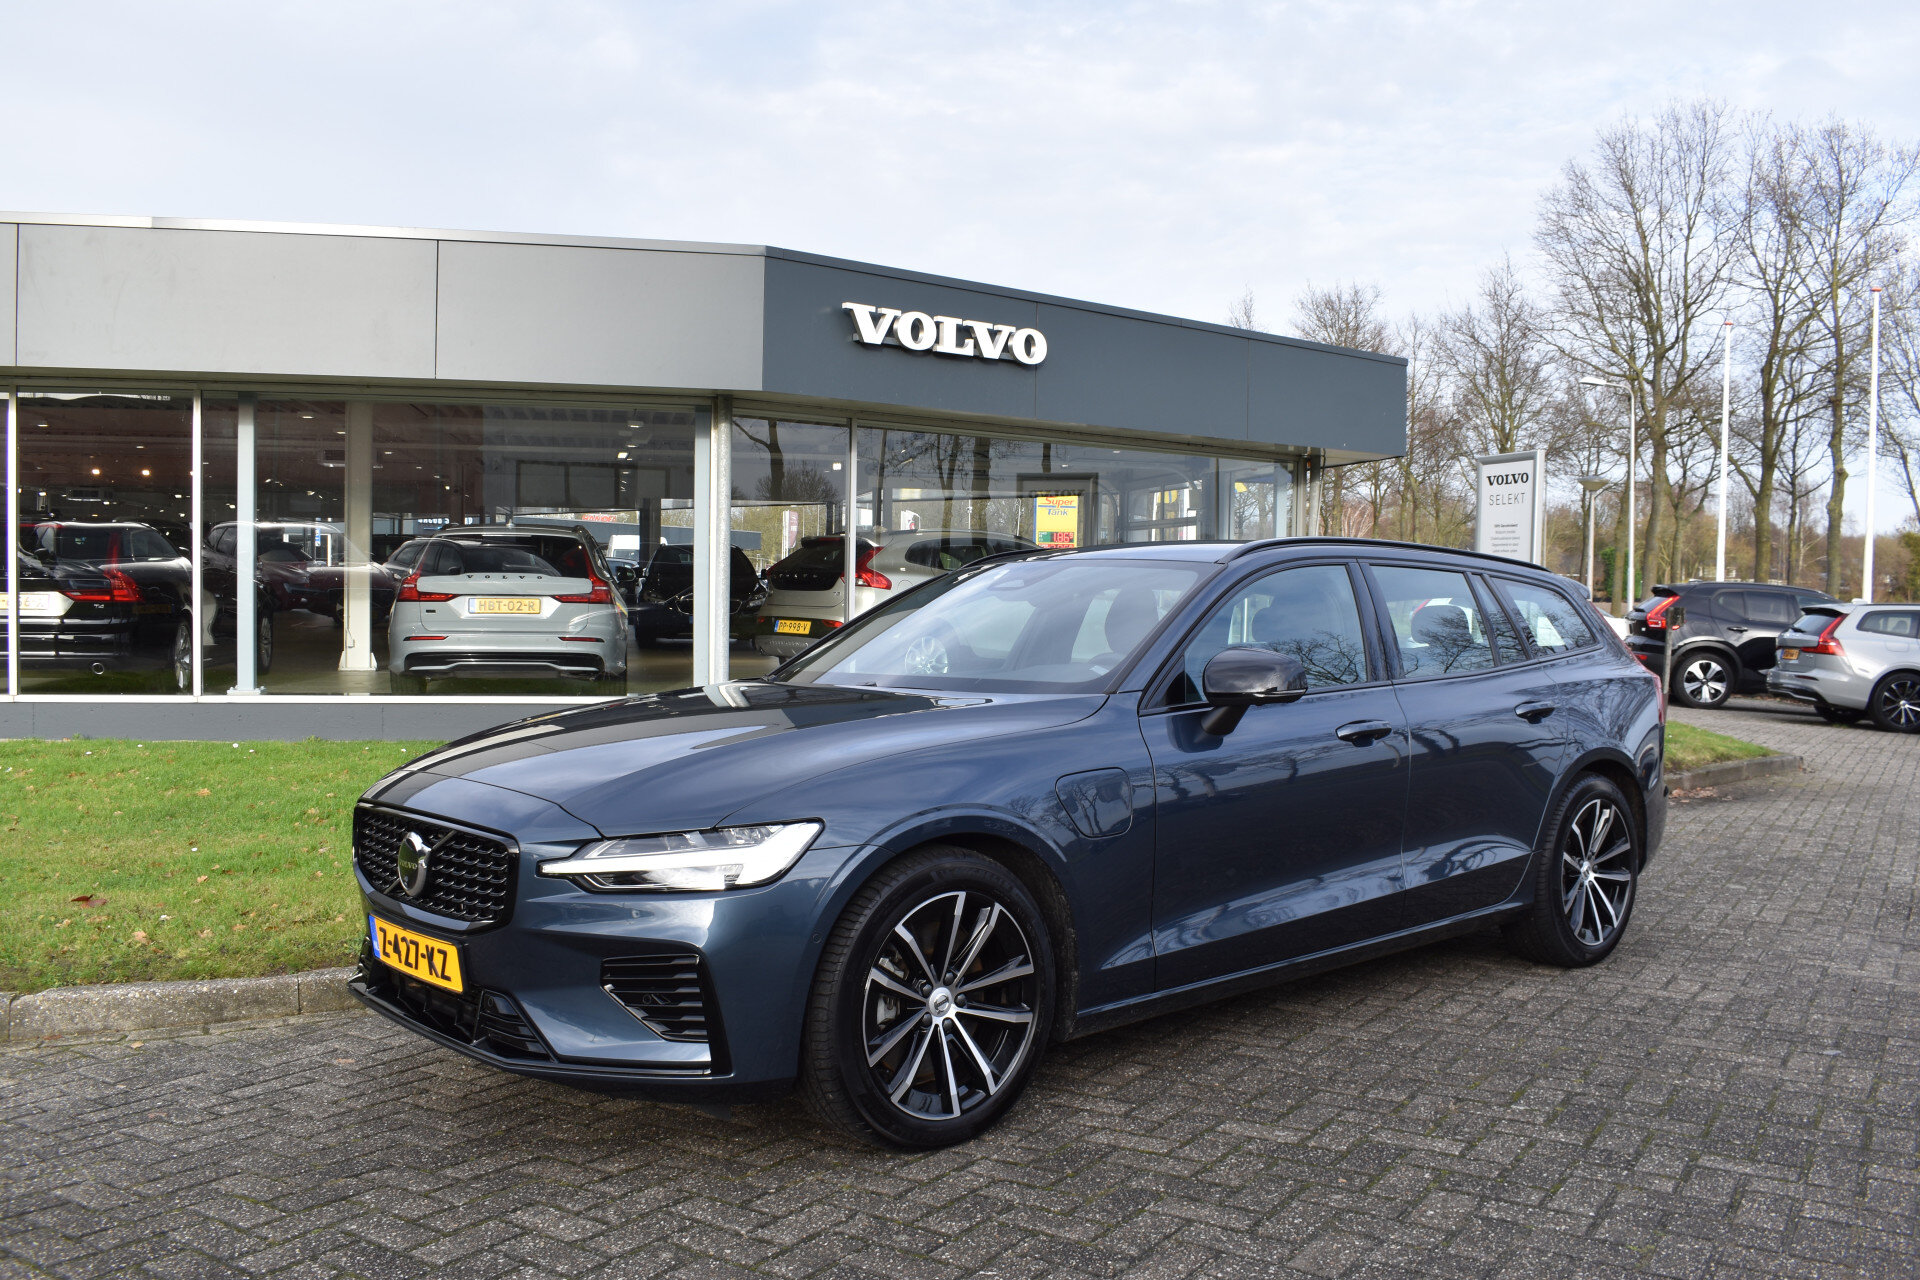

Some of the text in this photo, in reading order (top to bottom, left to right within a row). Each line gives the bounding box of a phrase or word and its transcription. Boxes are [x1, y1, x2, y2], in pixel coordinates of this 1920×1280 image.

[841, 302, 1048, 365] VOLVO
[1487, 472, 1529, 486] VOLVO
[1040, 497, 1074, 508] Super
[1489, 493, 1525, 505] SELEKT
[1047, 508, 1068, 516] Tank
[478, 600, 536, 611] HBT-02-R
[378, 926, 453, 982] Z-427-KZ
